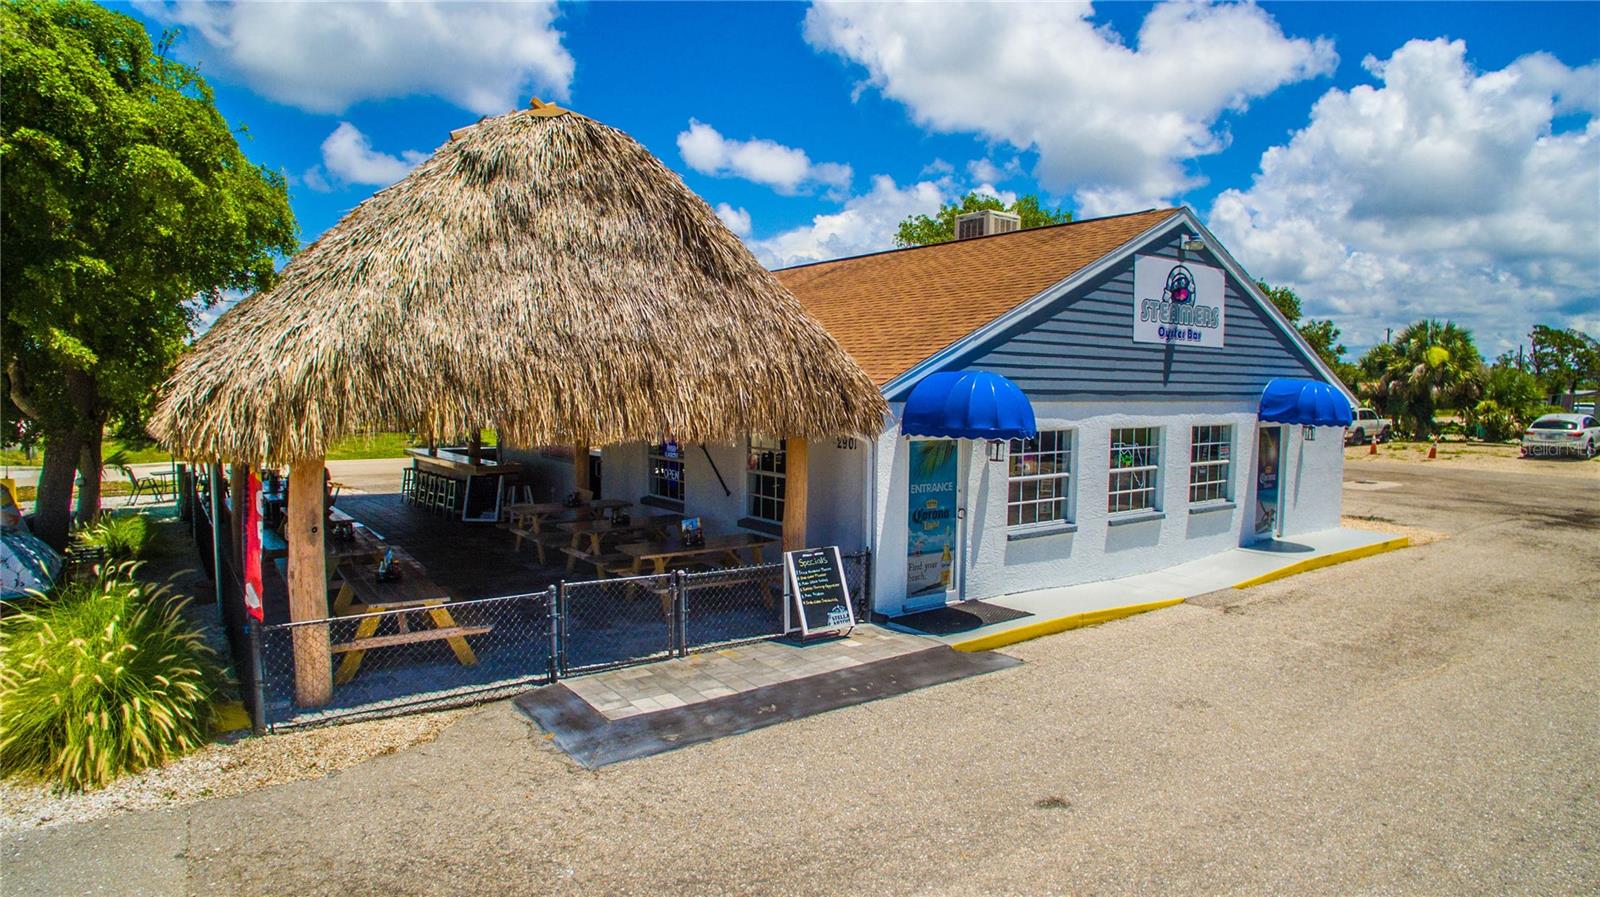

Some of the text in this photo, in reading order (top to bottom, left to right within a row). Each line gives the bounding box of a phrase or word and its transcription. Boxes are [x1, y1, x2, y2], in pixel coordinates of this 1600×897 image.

[1141, 298, 1219, 329] STEAMERS
[1158, 326, 1202, 341] Oyster Bar
[837, 437, 857, 450] 2901
[664, 468, 679, 480] OPEN
[911, 482, 953, 494] ENTRANCE
[912, 508, 950, 523] Corona
[798, 557, 828, 568] Specials
